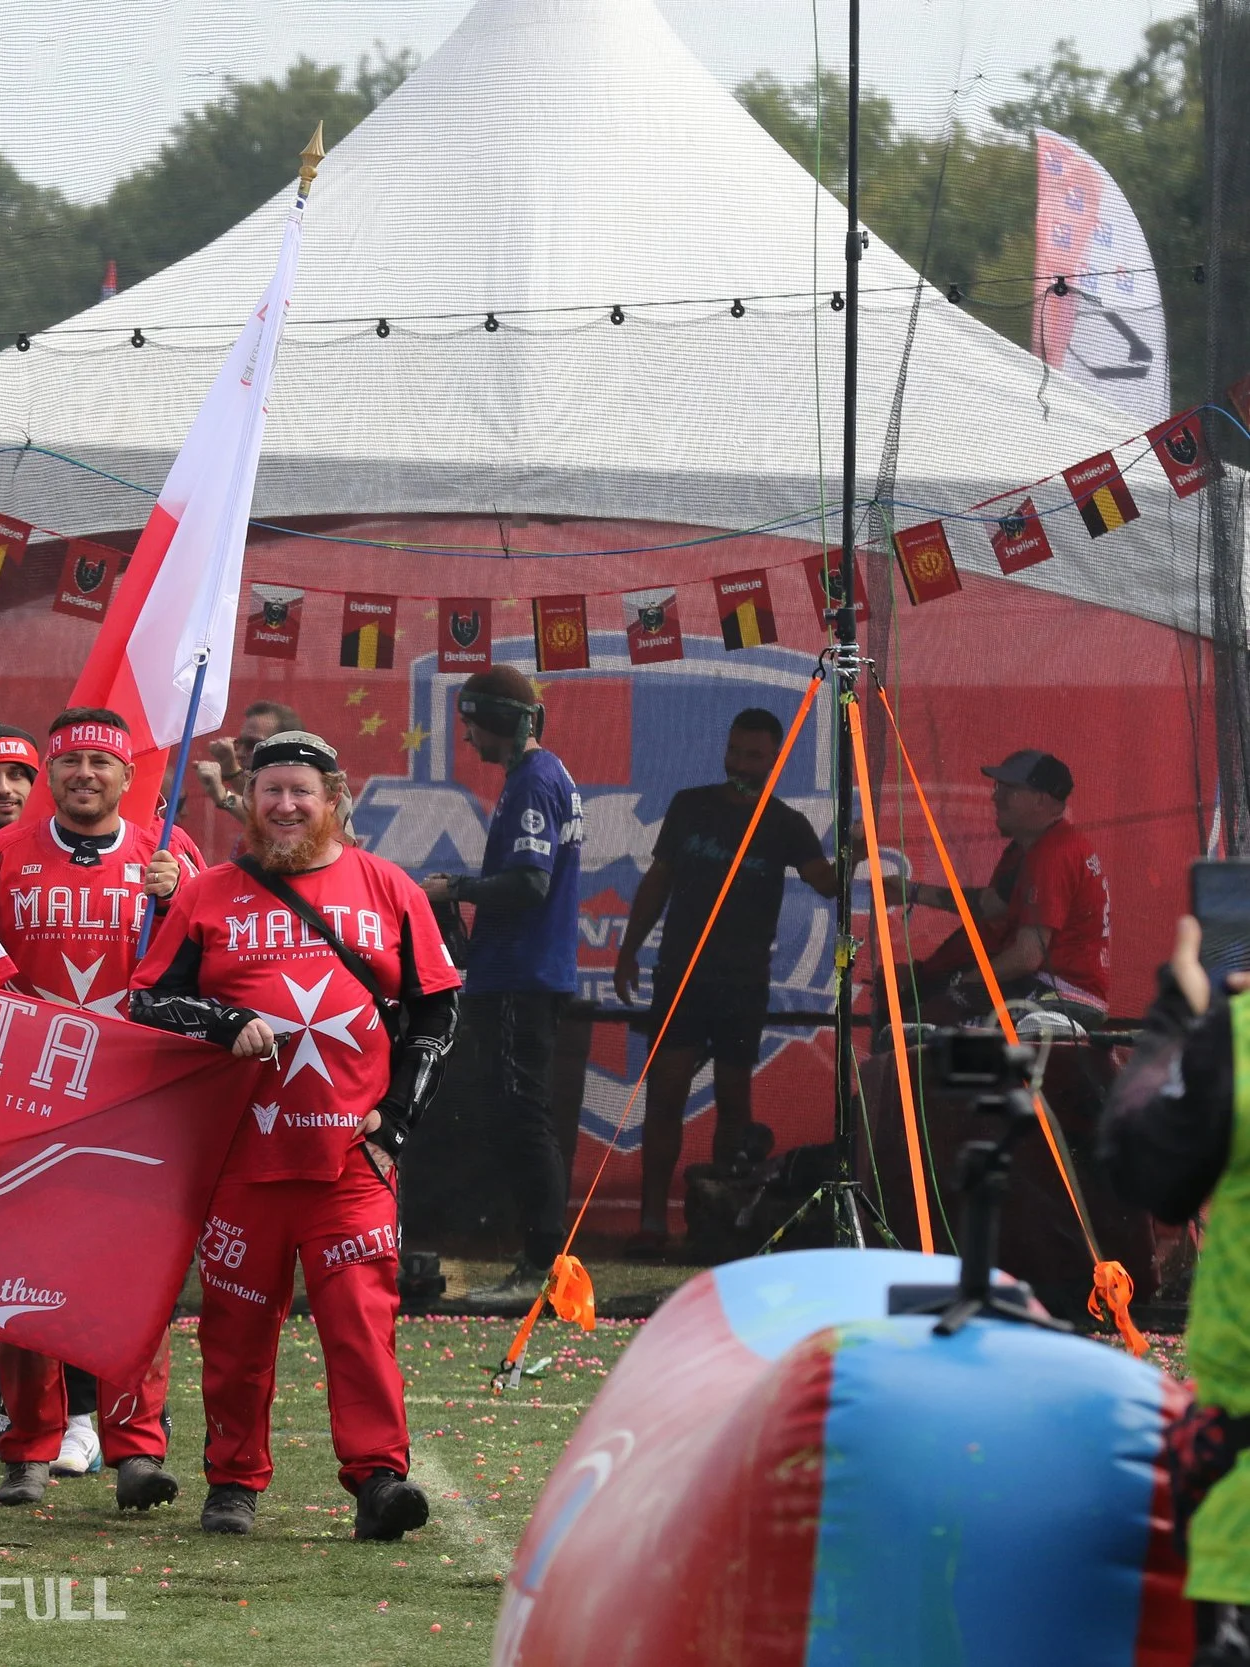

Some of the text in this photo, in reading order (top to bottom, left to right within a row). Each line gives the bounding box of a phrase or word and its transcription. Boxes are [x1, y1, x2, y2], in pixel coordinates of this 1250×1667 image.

[720, 579, 762, 595] Believe
[350, 602, 392, 615] Believe
[636, 636, 675, 650] Jupiler
[444, 651, 486, 662] Believe
[52, 735, 61, 753] 19
[71, 725, 123, 748] MALTA
[10, 886, 148, 932] MALTA
[71, 933, 119, 941] PAINTBALL
[225, 905, 384, 951] MALTA
[238, 953, 286, 962] NATIONAL
[5, 1093, 53, 1118] TEAM
[211, 1216, 244, 1237] EARLEY
[323, 1224, 395, 1267] MALTA
[206, 1272, 267, 1305] VisitMalta
